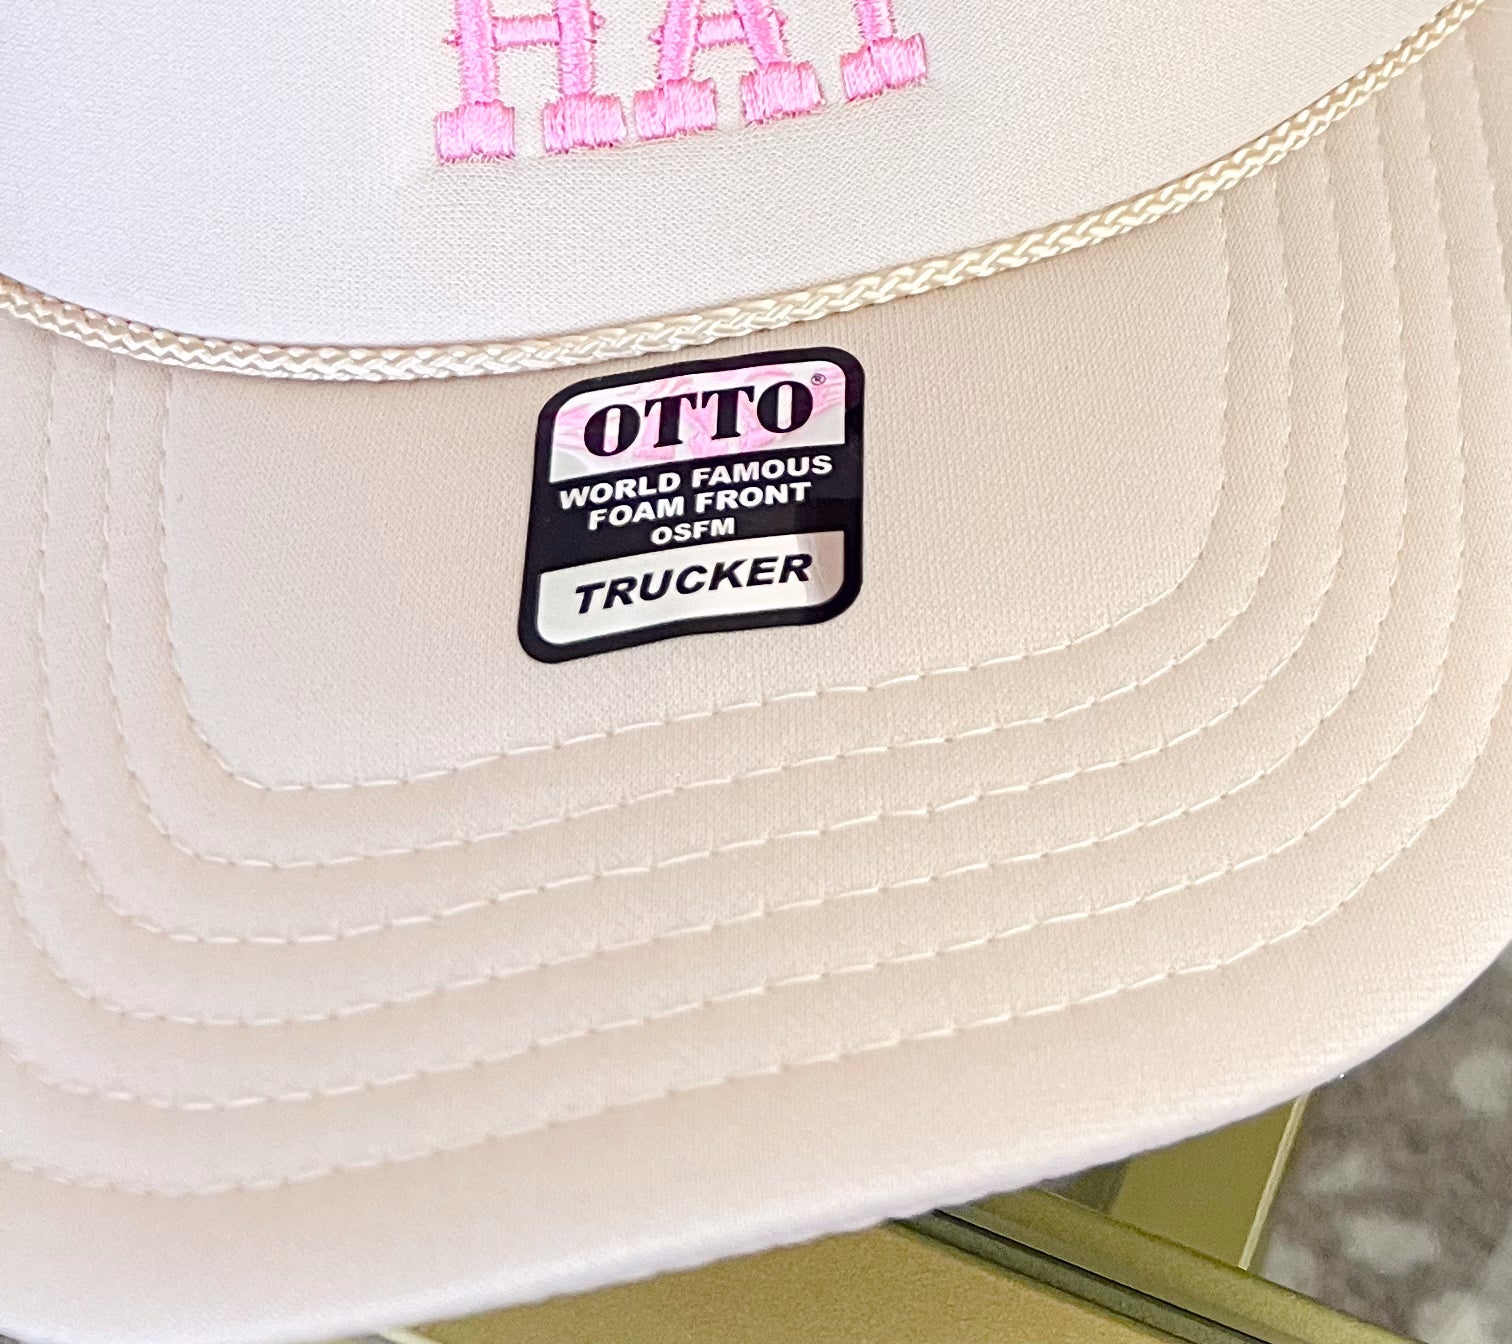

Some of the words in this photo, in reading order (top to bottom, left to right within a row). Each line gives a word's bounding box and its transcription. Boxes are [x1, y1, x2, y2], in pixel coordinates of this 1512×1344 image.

[559, 472, 682, 511] WORLD
[691, 454, 833, 490] FAMOUS
[588, 496, 685, 531] FOAM
[695, 481, 812, 513] FRONT
[651, 518, 736, 546] OSFM
[575, 553, 813, 615] TRUCKER
